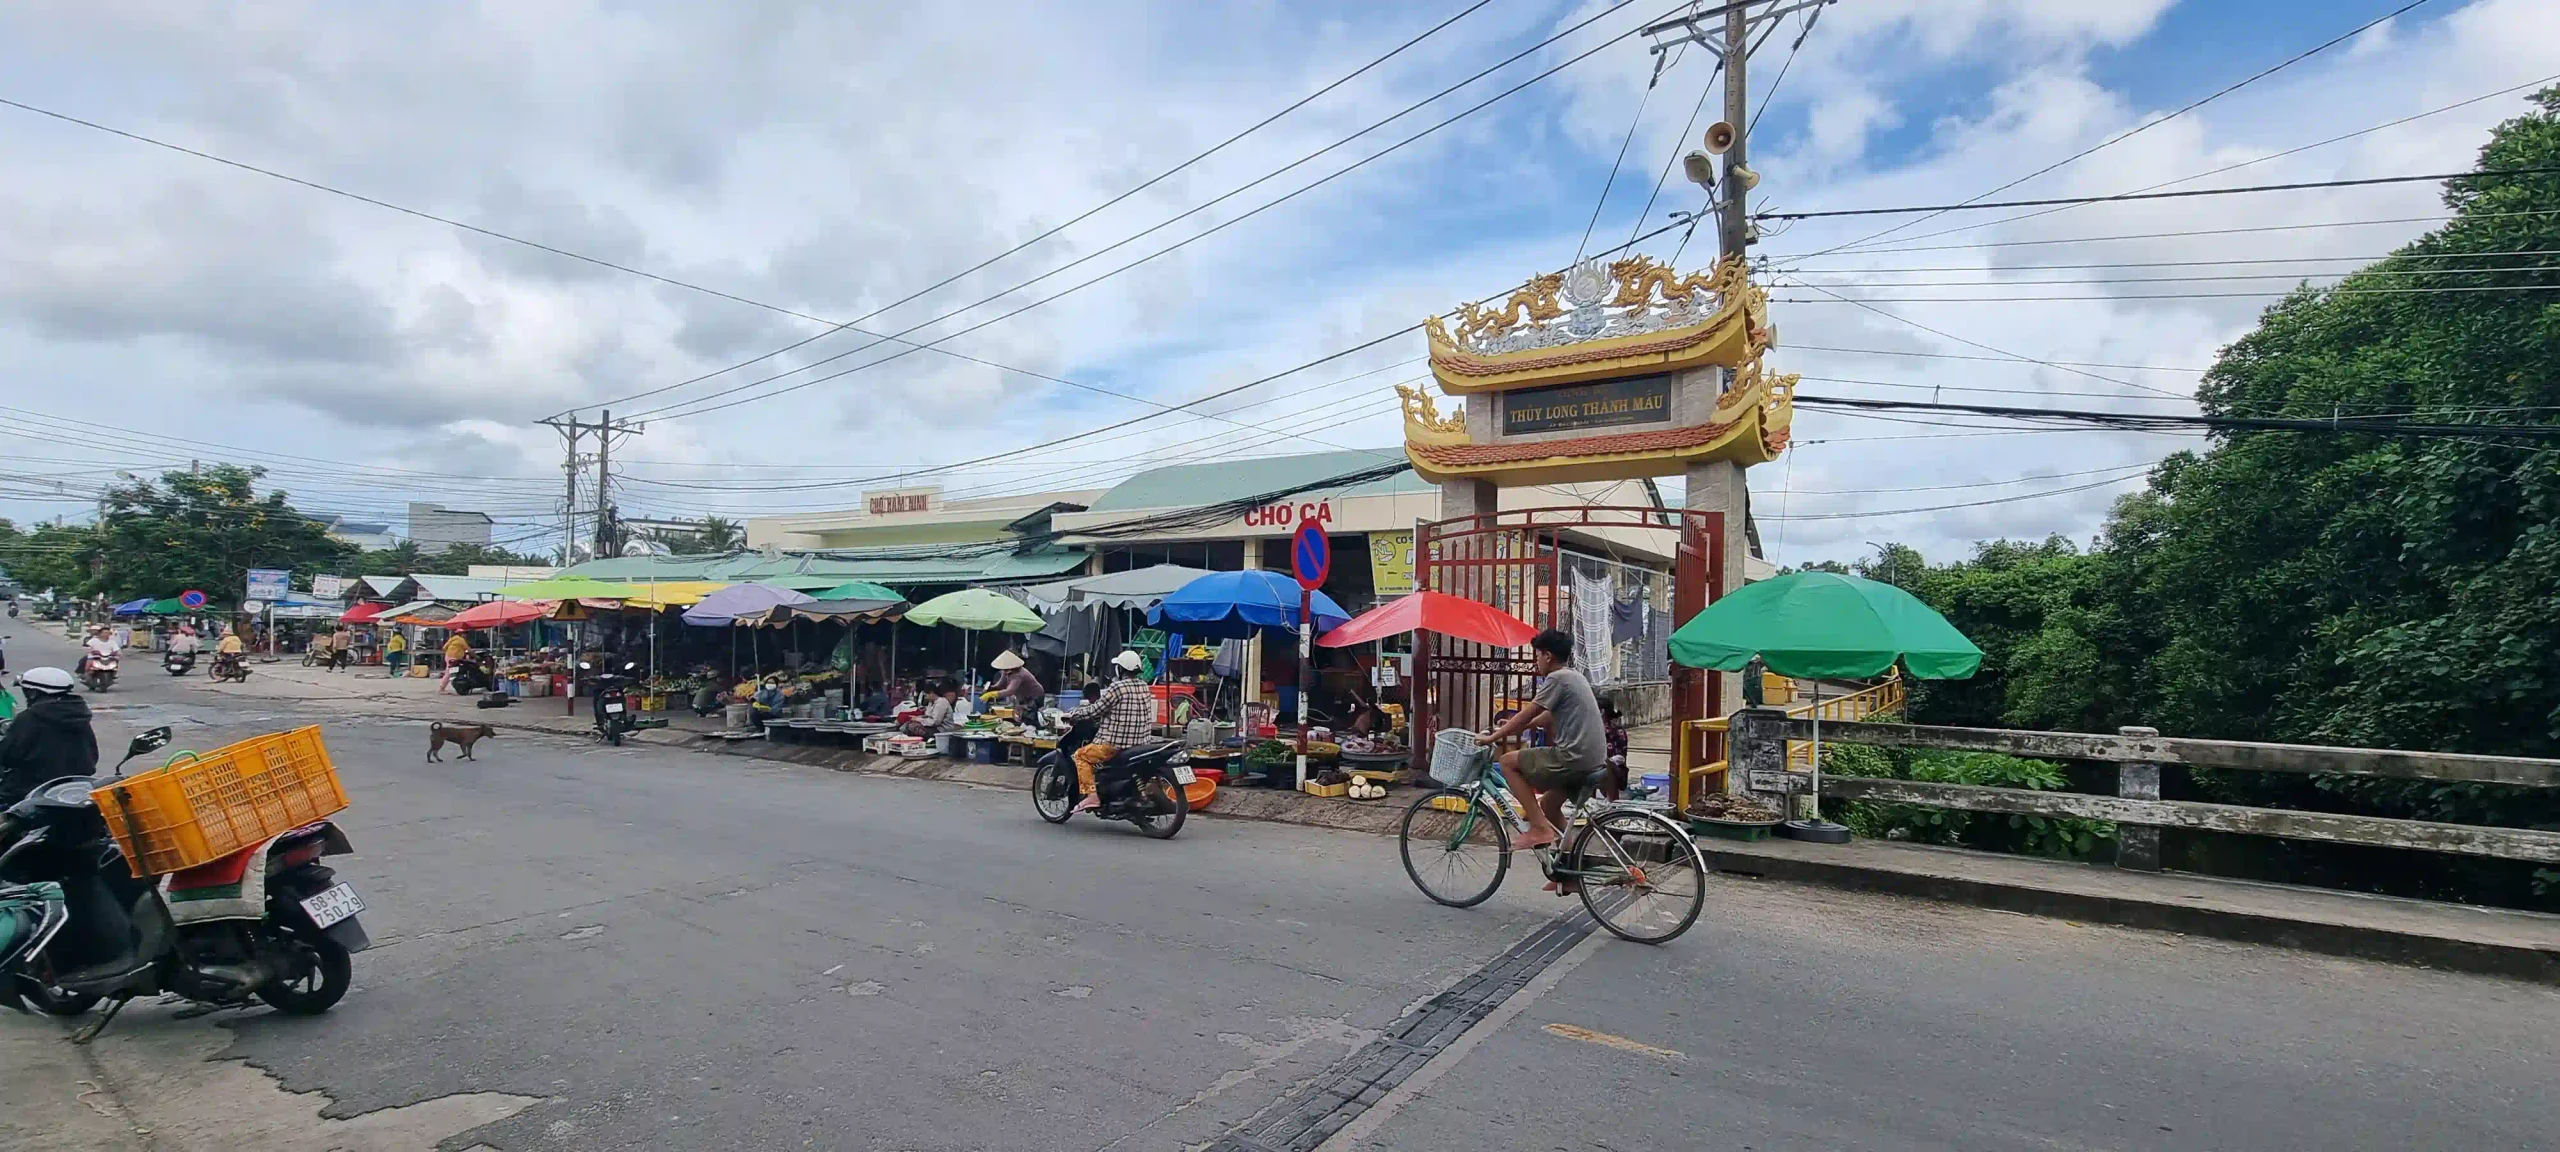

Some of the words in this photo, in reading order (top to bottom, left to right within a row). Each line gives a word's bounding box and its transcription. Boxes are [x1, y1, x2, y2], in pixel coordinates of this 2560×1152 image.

[1510, 404, 1542, 423] THỦY
[1546, 404, 1578, 420] LONG
[1582, 397, 1628, 417] THÁNH
[1244, 502, 1293, 530] CHỢ
[1300, 498, 1332, 523] CÁ
[309, 887, 348, 911] 68-P1
[315, 896, 362, 926] 750.29
